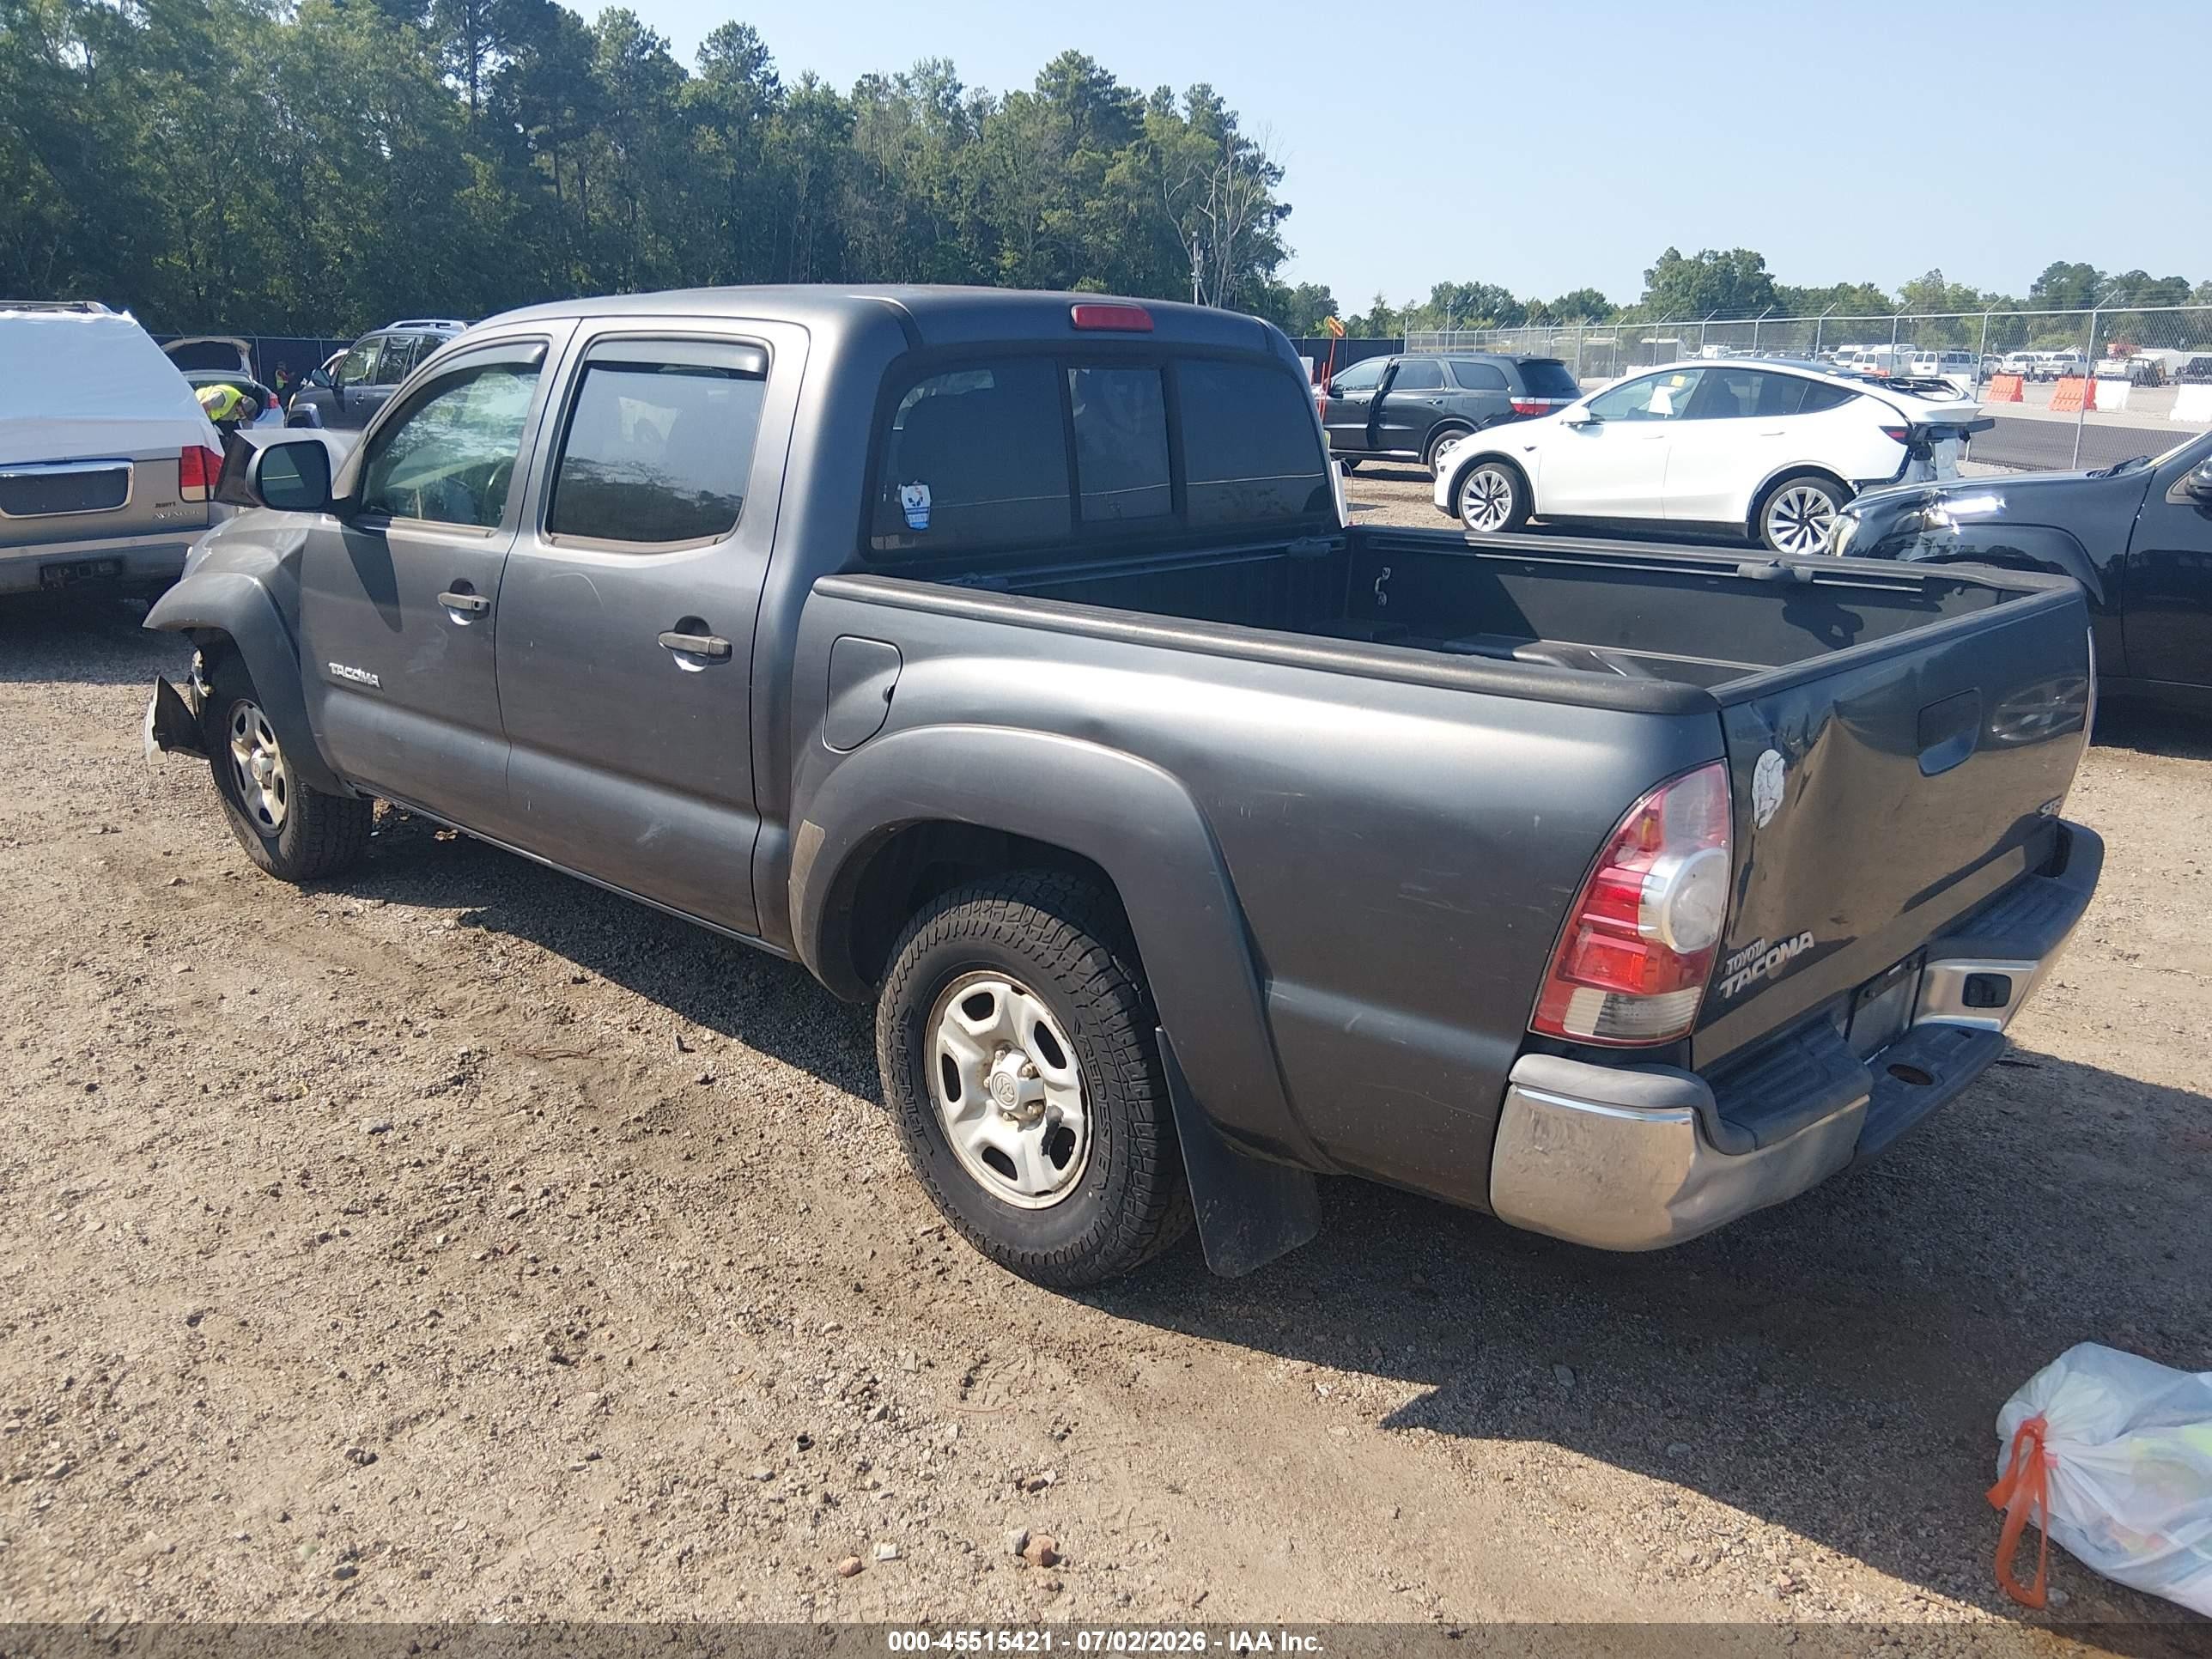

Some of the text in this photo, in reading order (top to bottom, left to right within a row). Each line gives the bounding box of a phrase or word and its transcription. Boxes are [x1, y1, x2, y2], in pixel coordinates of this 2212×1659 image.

[328, 662, 380, 688] TACOMA
[1719, 931, 1814, 999] TACOMA
[1725, 938, 1765, 975] TOYOTA
